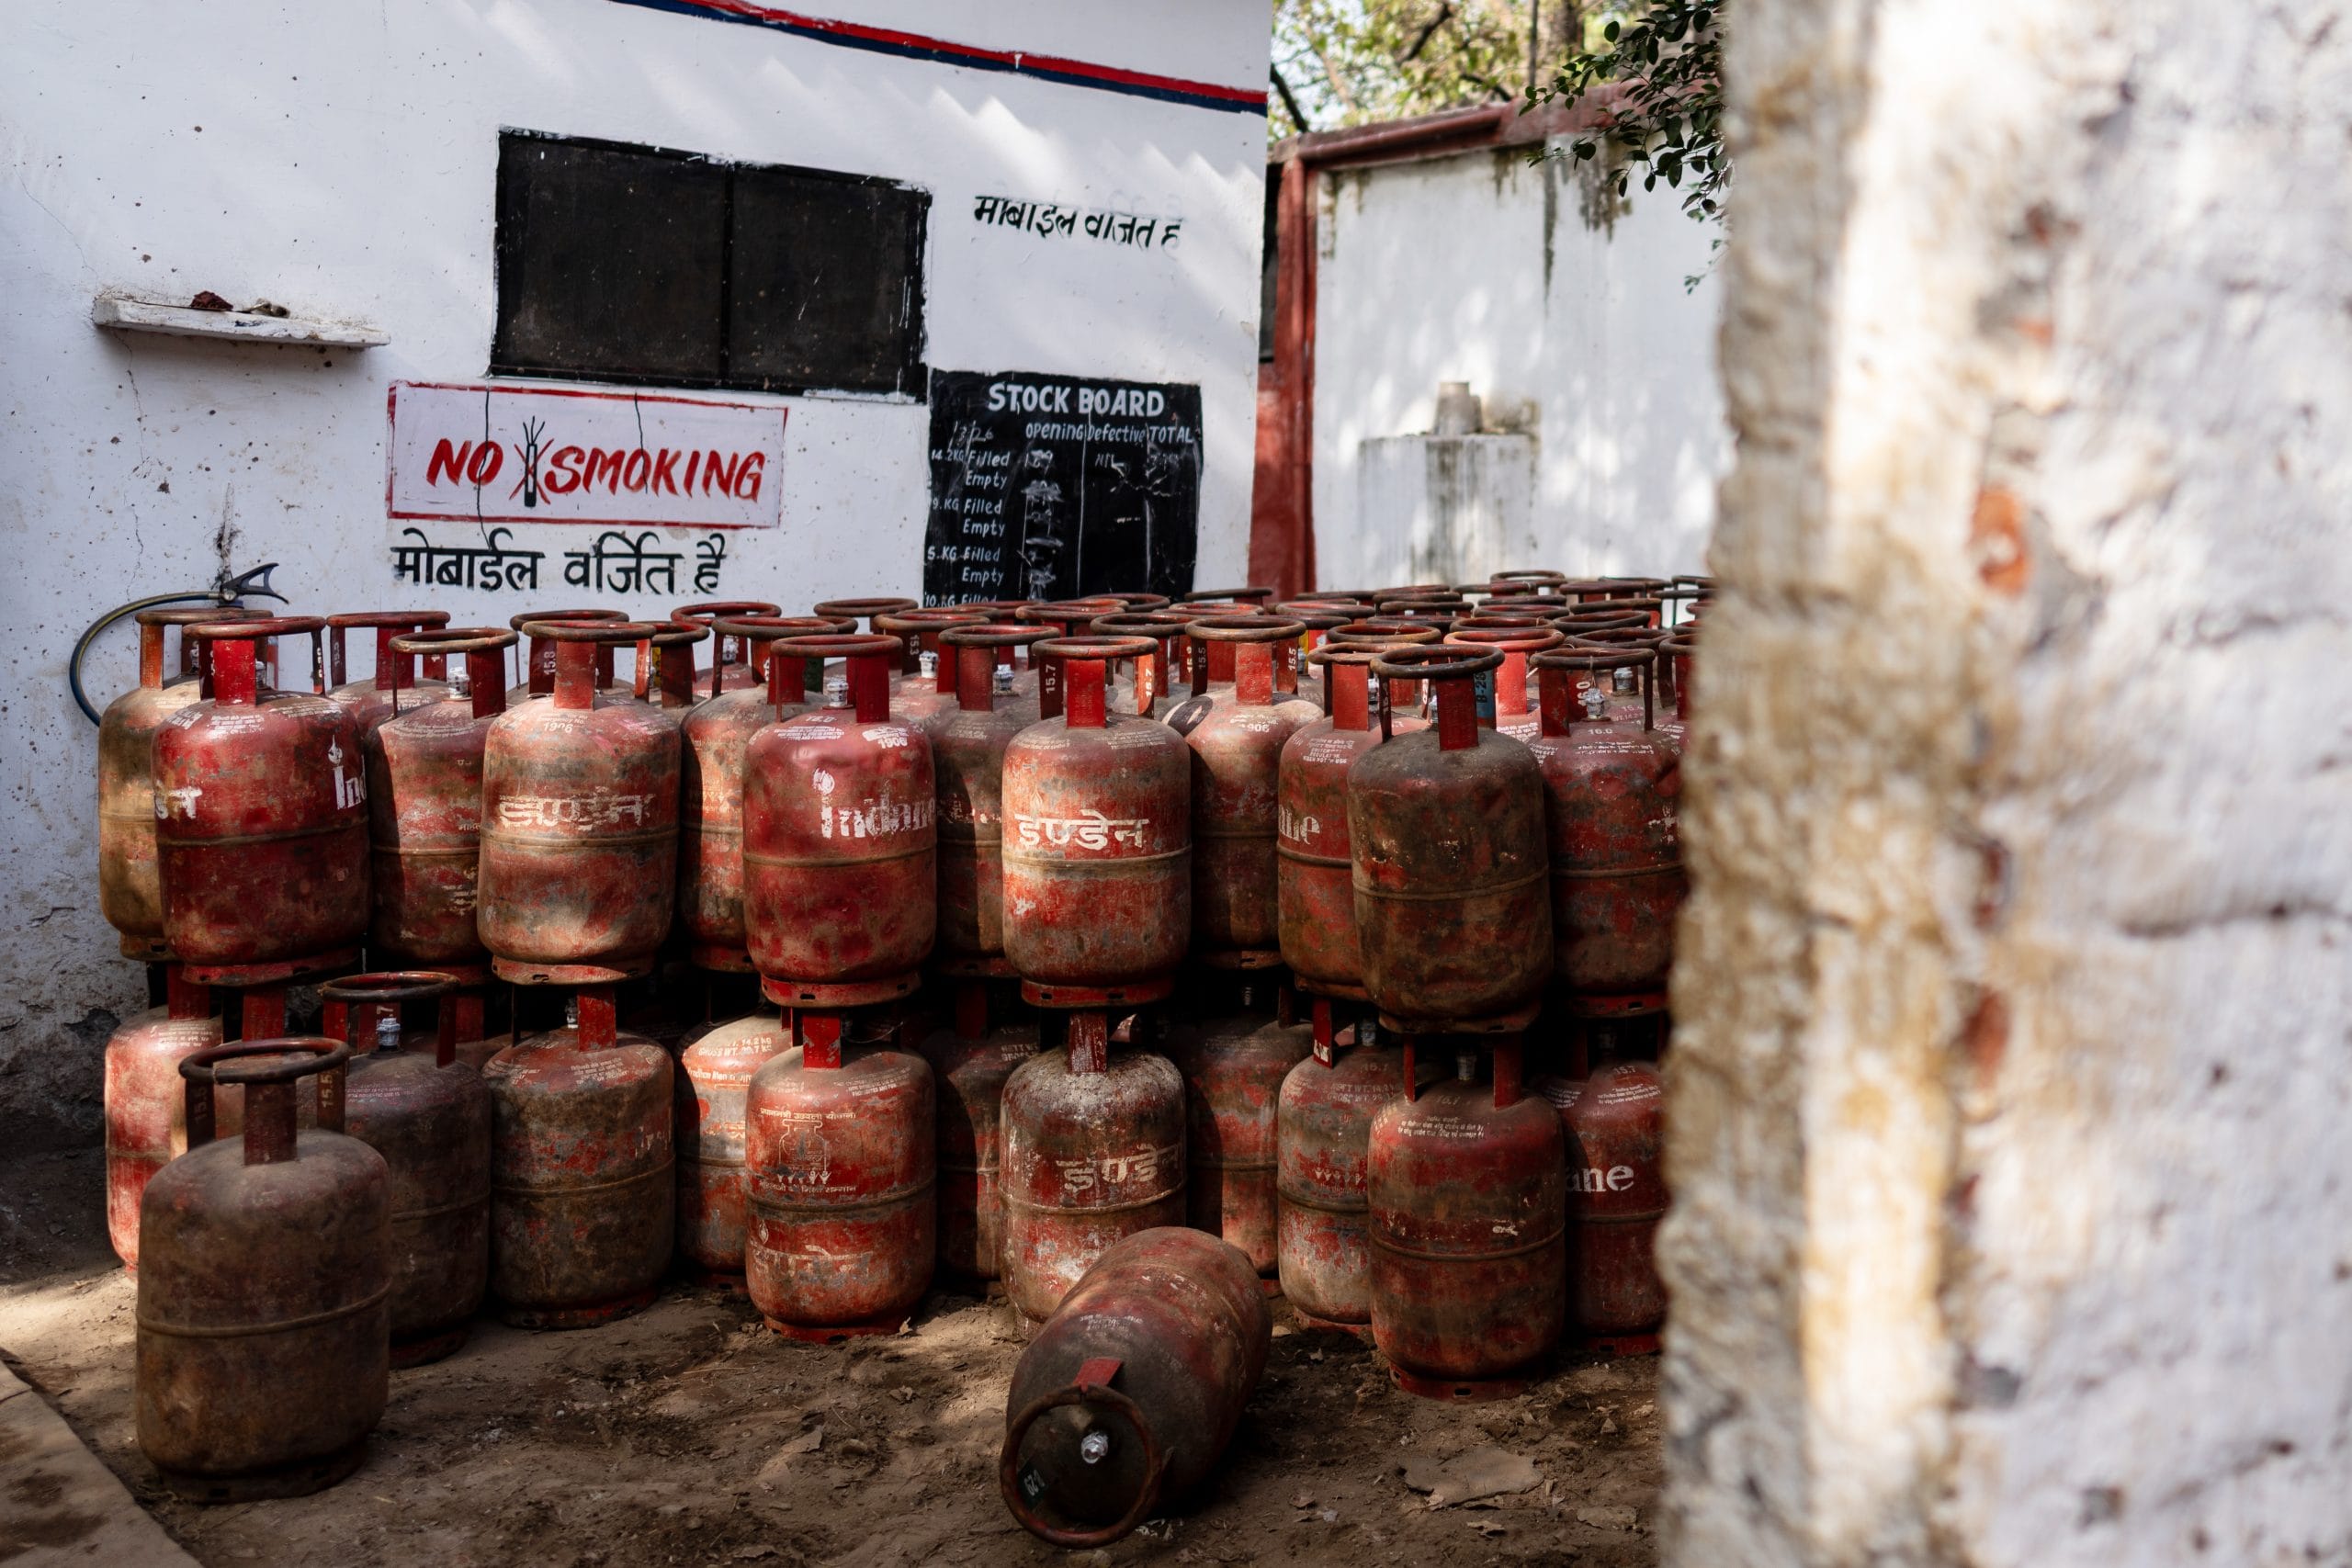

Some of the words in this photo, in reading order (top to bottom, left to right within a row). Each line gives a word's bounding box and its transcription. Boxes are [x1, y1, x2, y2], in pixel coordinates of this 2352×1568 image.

[987, 383, 1071, 414] STOCK
[1079, 387, 1164, 417] BOARD
[1088, 423, 1146, 443] Defective
[1149, 425, 1193, 444] TOTAL
[426, 437, 504, 487] NO
[545, 445, 765, 503] SMOKING
[967, 449, 1011, 468] Filled
[965, 470, 1008, 490] Empty
[964, 499, 1002, 514] Filled
[962, 519, 1005, 538] Empty
[693, 533, 728, 595] है
[963, 547, 1001, 562] Filled
[961, 566, 1004, 589] Empty
[544, 650, 556, 676] 15.8
[1288, 647, 1296, 671] 15.5
[1046, 664, 1057, 695] 15.7
[878, 737, 908, 749] 1906
[321, 1073, 334, 1109] 15.5
